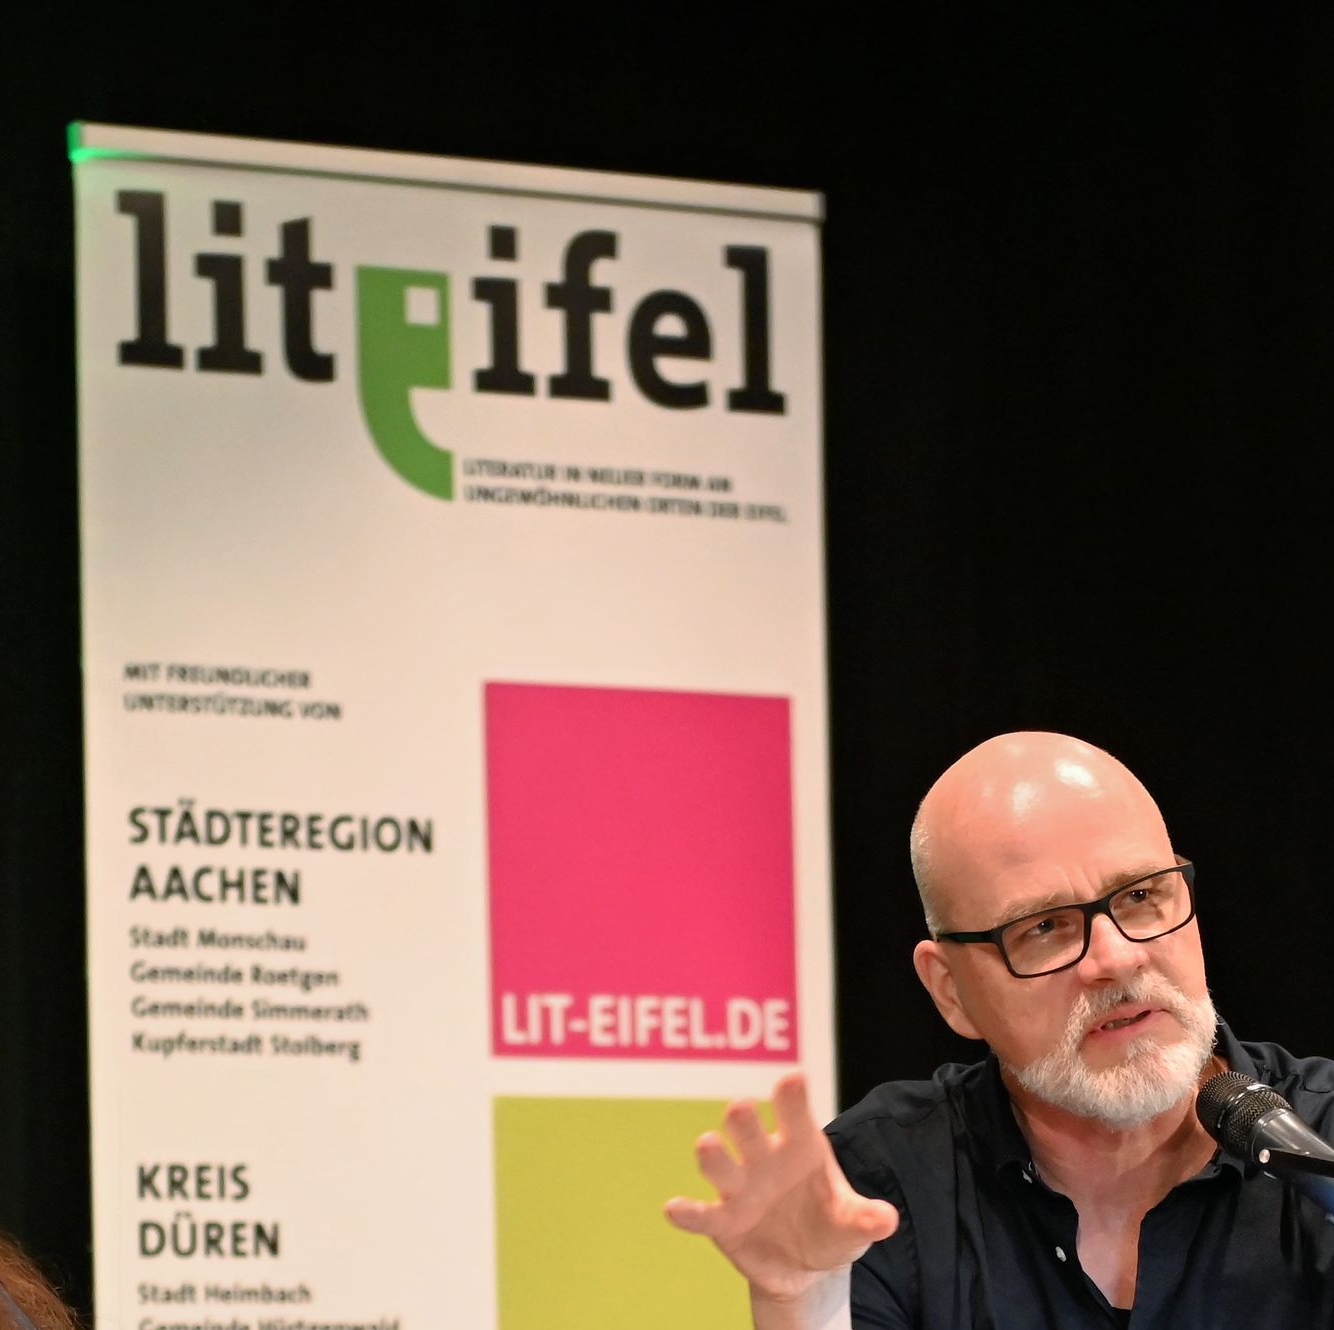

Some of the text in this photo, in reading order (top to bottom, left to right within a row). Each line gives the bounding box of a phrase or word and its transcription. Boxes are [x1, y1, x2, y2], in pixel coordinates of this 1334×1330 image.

[123, 662, 312, 689] MIT FREUNDLICHER
[123, 691, 342, 720] UNTERSTÜTZUNG VON
[128, 798, 434, 853] STÄDTEREGION
[129, 864, 301, 905] AACHEN
[130, 926, 306, 951] Stadt Monschau
[130, 961, 340, 992] Gemeinde Roetgen
[131, 997, 368, 1021] Gemeinde Simmerath
[501, 992, 791, 1051] LIT-EIFEL.DE
[132, 1031, 361, 1062] Kupferstadt Stolberg
[137, 1164, 250, 1201] KREIS
[138, 1211, 280, 1258] DÜREN
[138, 1283, 312, 1303] Stadt Heimbach
